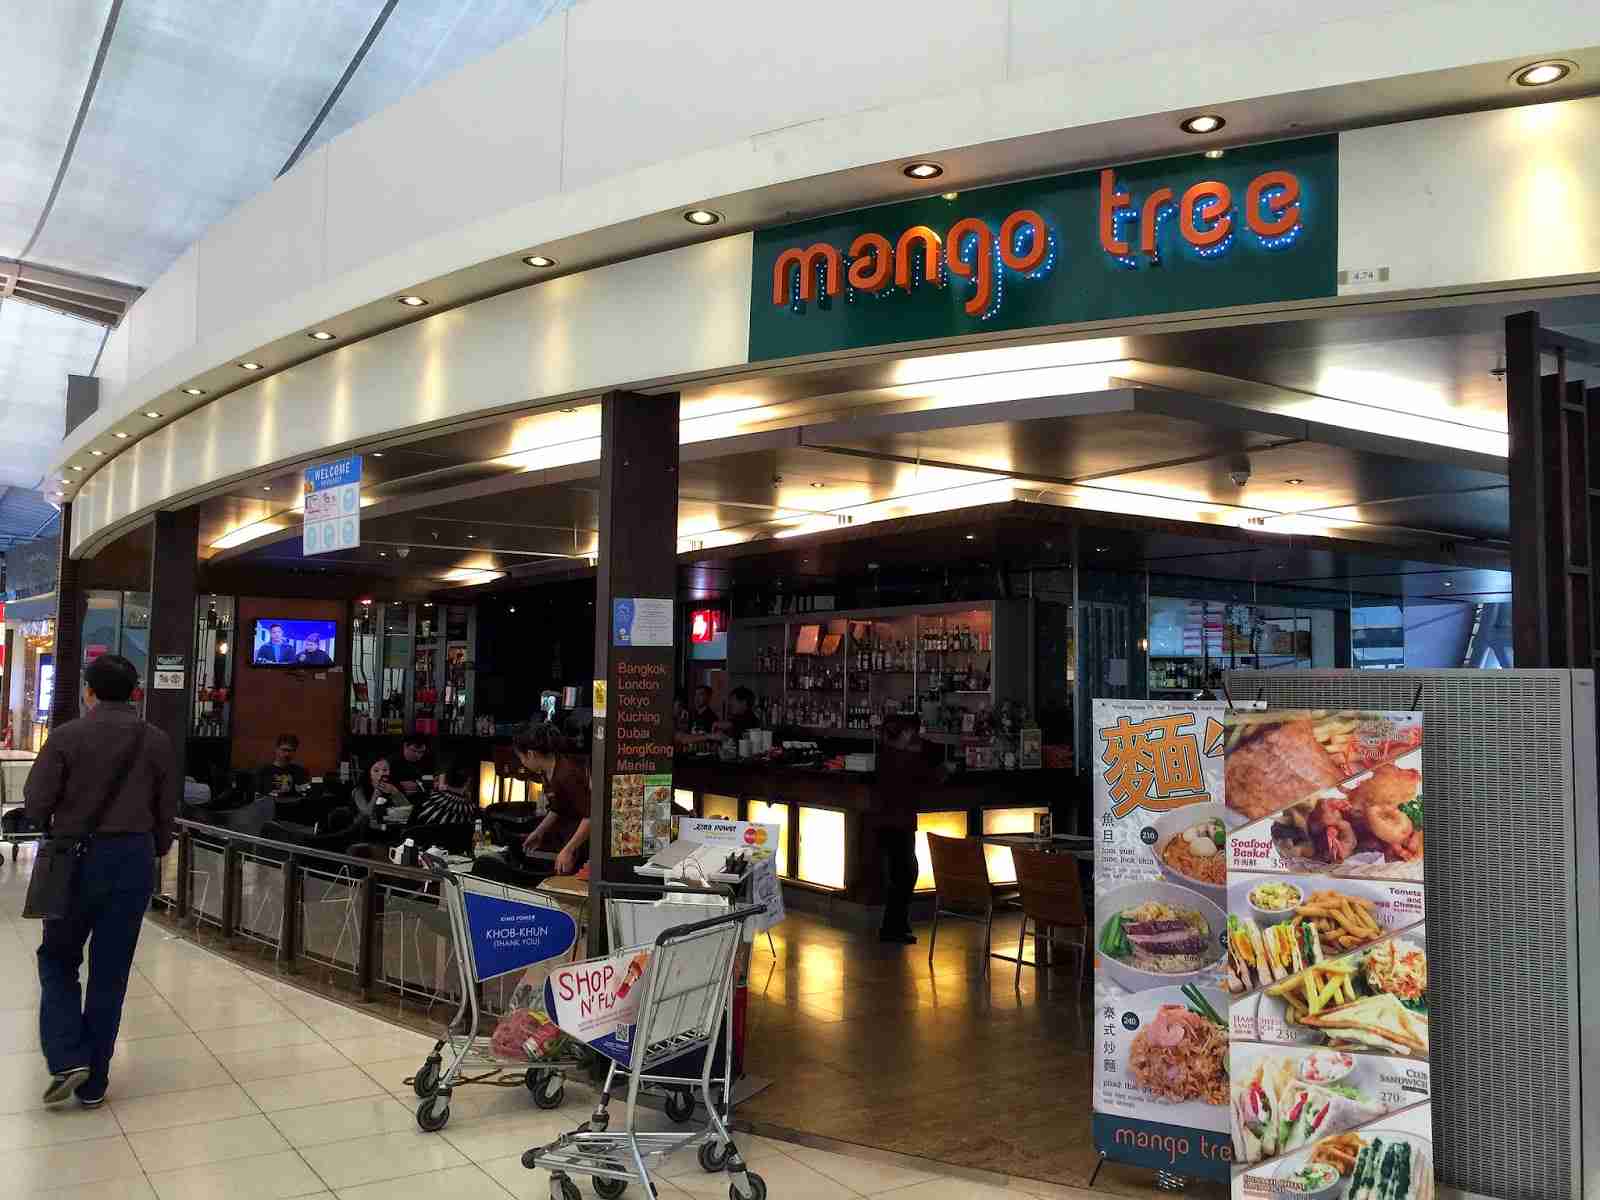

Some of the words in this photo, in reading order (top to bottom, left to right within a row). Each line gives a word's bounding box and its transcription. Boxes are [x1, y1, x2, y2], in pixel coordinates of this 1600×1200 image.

[773, 209, 1048, 316] mango
[1100, 169, 1301, 257] tree
[314, 461, 351, 481] WELCOME
[617, 662, 666, 676] Bangkok
[617, 679, 660, 690] London
[618, 694, 650, 708] Tokyo
[617, 711, 661, 725] Kuching
[617, 727, 650, 739] Dubai
[616, 759, 656, 771] Manila
[1231, 838, 1273, 849] Seafood
[1233, 847, 1270, 858] Basket
[485, 926, 549, 939] KHOB-KHUN
[558, 964, 614, 1001] SHOP
[598, 991, 617, 1009] FLY
[1114, 1128, 1189, 1165] mango
